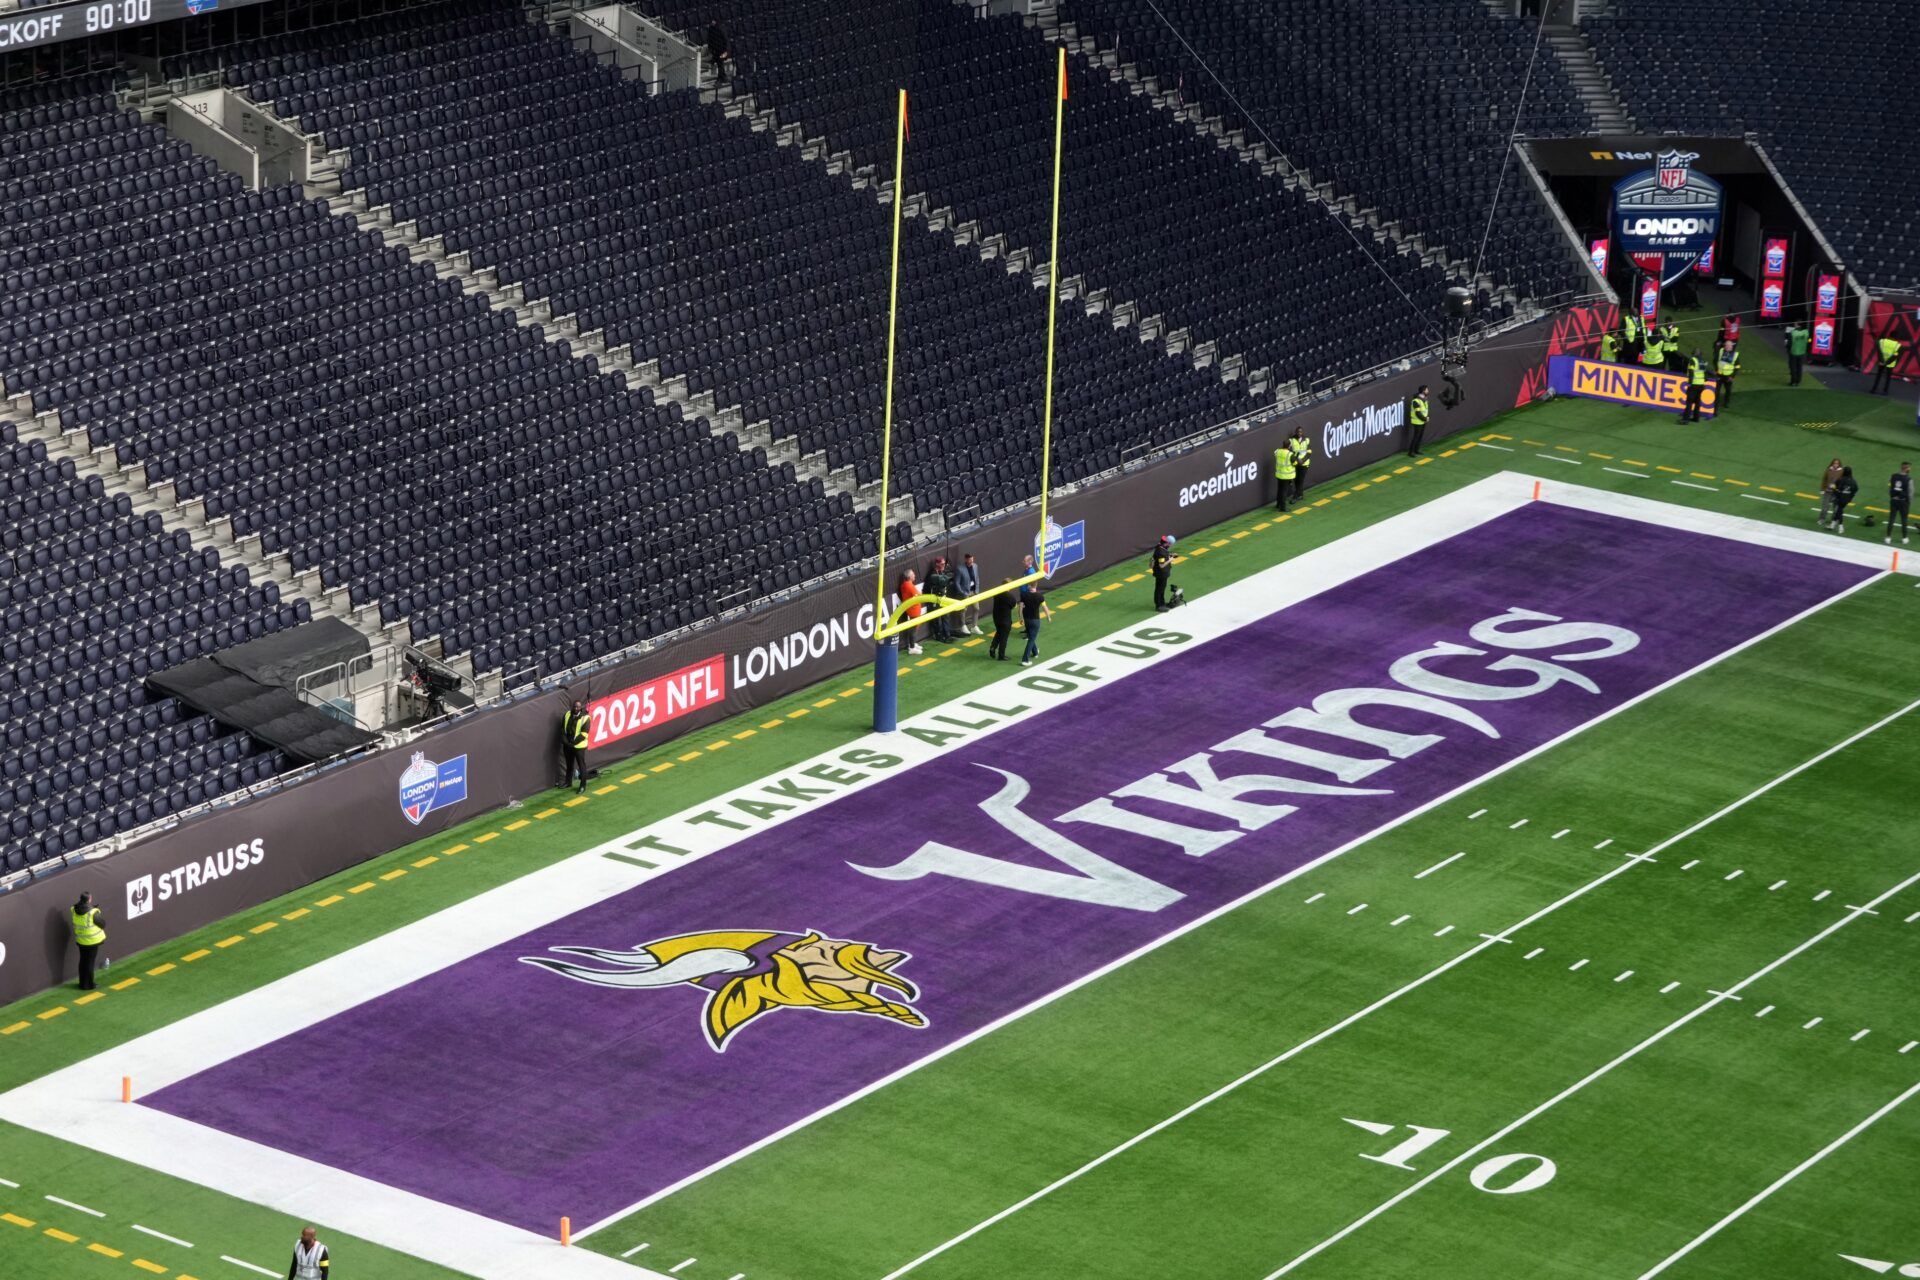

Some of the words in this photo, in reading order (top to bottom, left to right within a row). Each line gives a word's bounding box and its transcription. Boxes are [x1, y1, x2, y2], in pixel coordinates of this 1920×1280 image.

[86, 0, 151, 32] 90:00
[1660, 169, 1685, 187] NFL
[1622, 218, 1715, 236] LONDON
[1648, 237, 1687, 245] GAMES
[1323, 411, 1363, 459] Captain
[1362, 401, 1404, 443] Morgan
[1179, 461, 1258, 508] accenture
[1037, 541, 1062, 557] LNDON
[592, 686, 656, 742] 2025
[667, 666, 719, 715] NFL
[733, 613, 850, 689] LONDON
[602, 835, 691, 869] IT
[684, 748, 904, 830] TAKES
[902, 700, 1031, 747] ALL
[1017, 660, 1102, 694] OF
[1096, 627, 1193, 659] US
[402, 781, 435, 800] LONDON
[158, 838, 265, 900] STRAUSS
